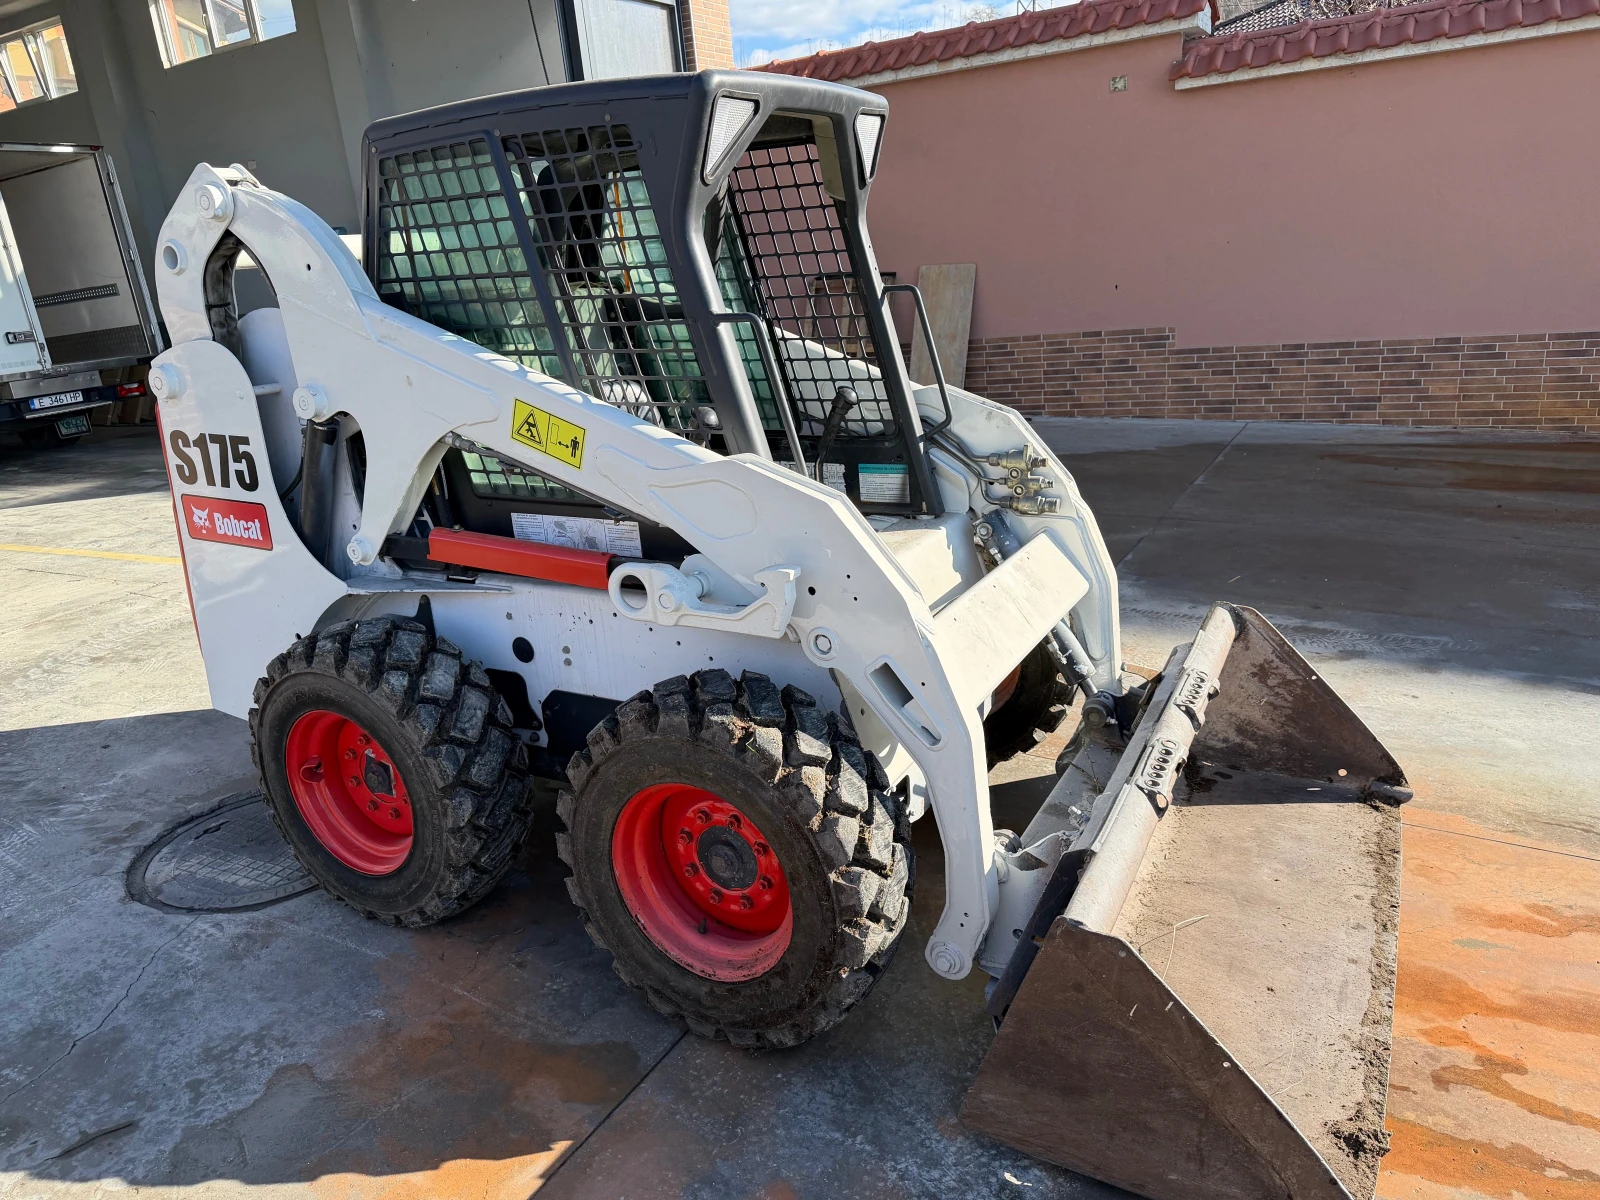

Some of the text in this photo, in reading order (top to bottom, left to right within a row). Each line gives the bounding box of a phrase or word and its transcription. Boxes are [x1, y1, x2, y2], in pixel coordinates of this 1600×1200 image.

[38, 397, 45, 407] E
[170, 430, 259, 492] S175
[213, 512, 263, 541] Bobcat
